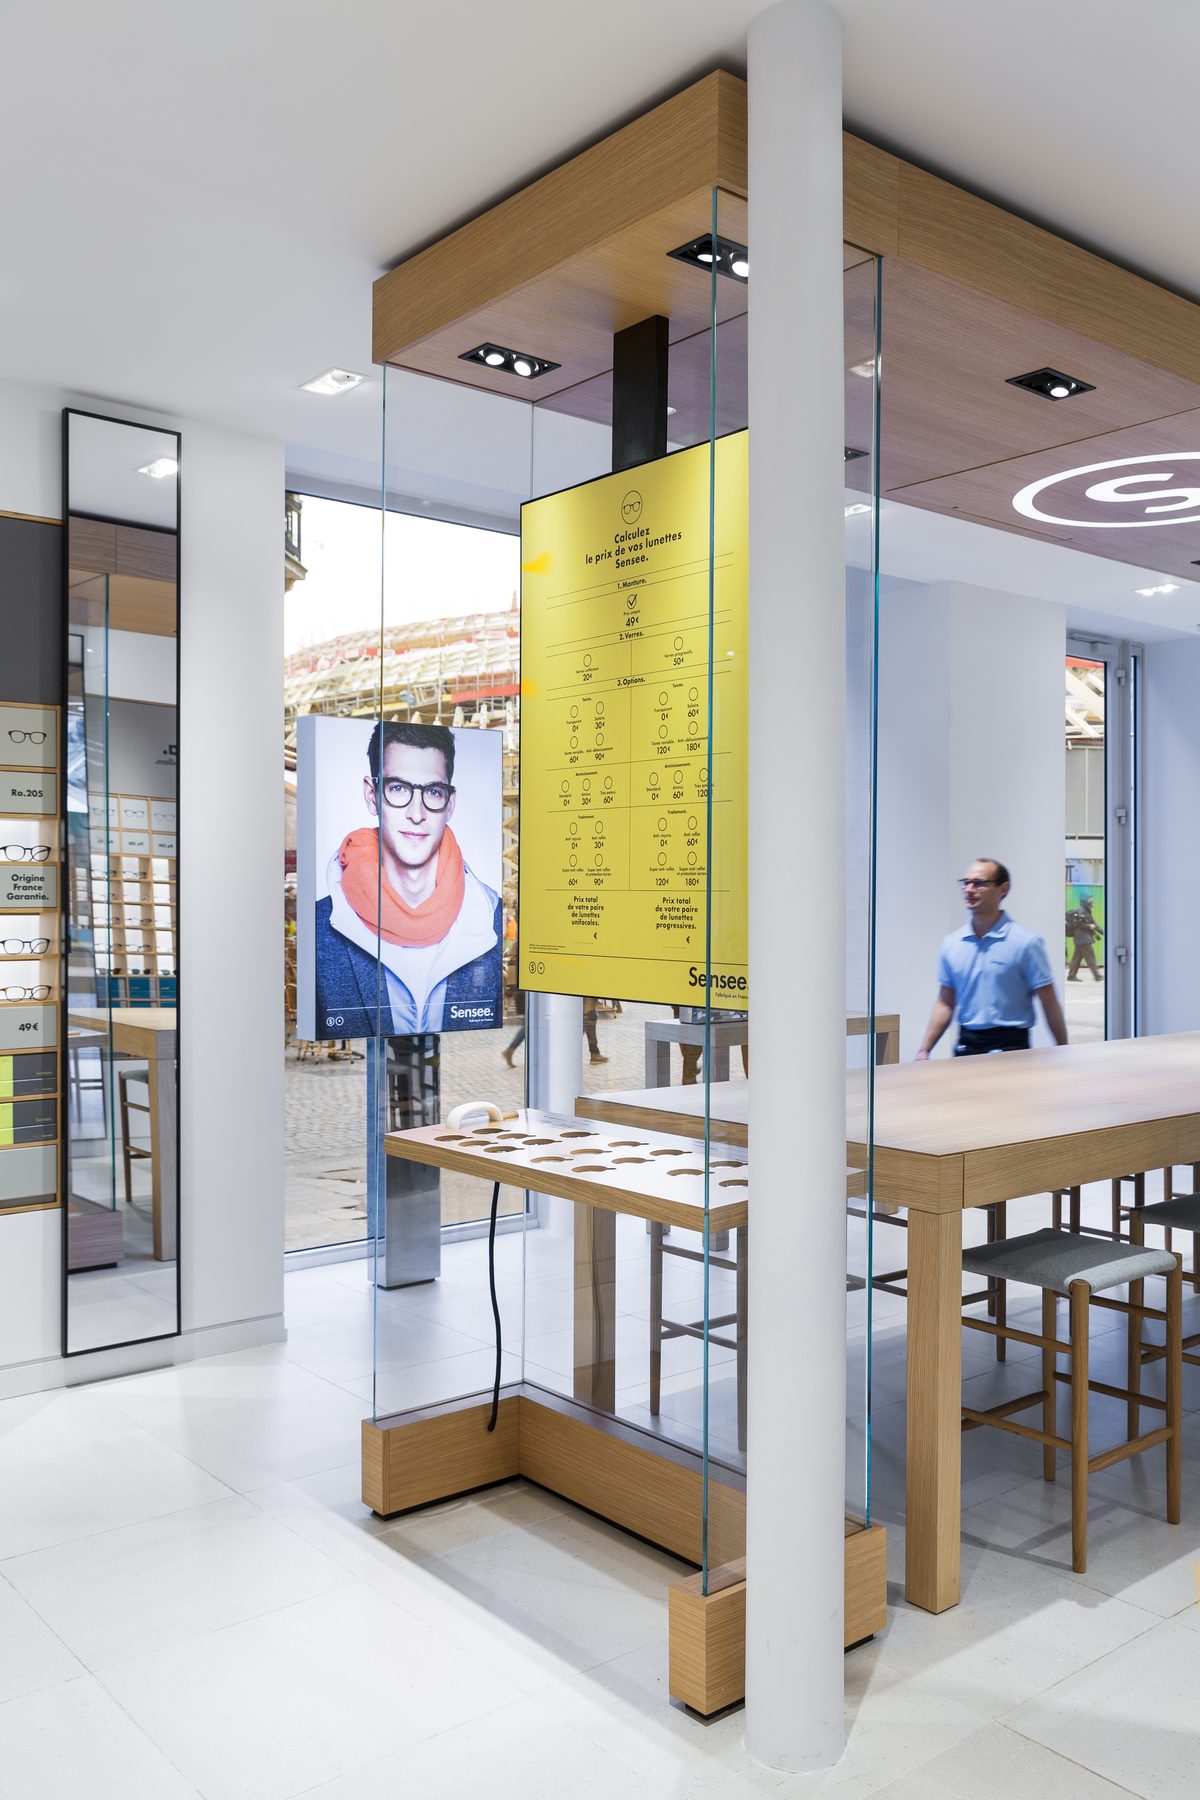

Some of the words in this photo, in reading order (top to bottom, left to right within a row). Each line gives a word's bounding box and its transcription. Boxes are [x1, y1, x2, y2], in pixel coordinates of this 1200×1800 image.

[614, 527, 650, 544] Calculez
[586, 554, 593, 564] le
[595, 549, 612, 565] prix
[615, 546, 625, 556] de
[628, 542, 642, 552] vos
[646, 532, 682, 548] lunettes
[616, 554, 649, 568] Sensee.
[622, 579, 647, 588] Monture.
[626, 616, 639, 627] 49€
[673, 658, 684, 666] 50€
[623, 677, 646, 686] Options.
[688, 709, 699, 717] 60€
[657, 746, 670, 754] 120€
[686, 743, 700, 751] 180€
[11, 789, 44, 797] Ro.205
[673, 791, 684, 799] 60€
[687, 838, 698, 846] 60€
[11, 874, 45, 883] Origine
[656, 878, 669, 886] 120€
[686, 878, 699, 886] 180€
[682, 906, 698, 914] paire
[656, 922, 697, 930] progressives.
[450, 1005, 494, 1019] Sensee.
